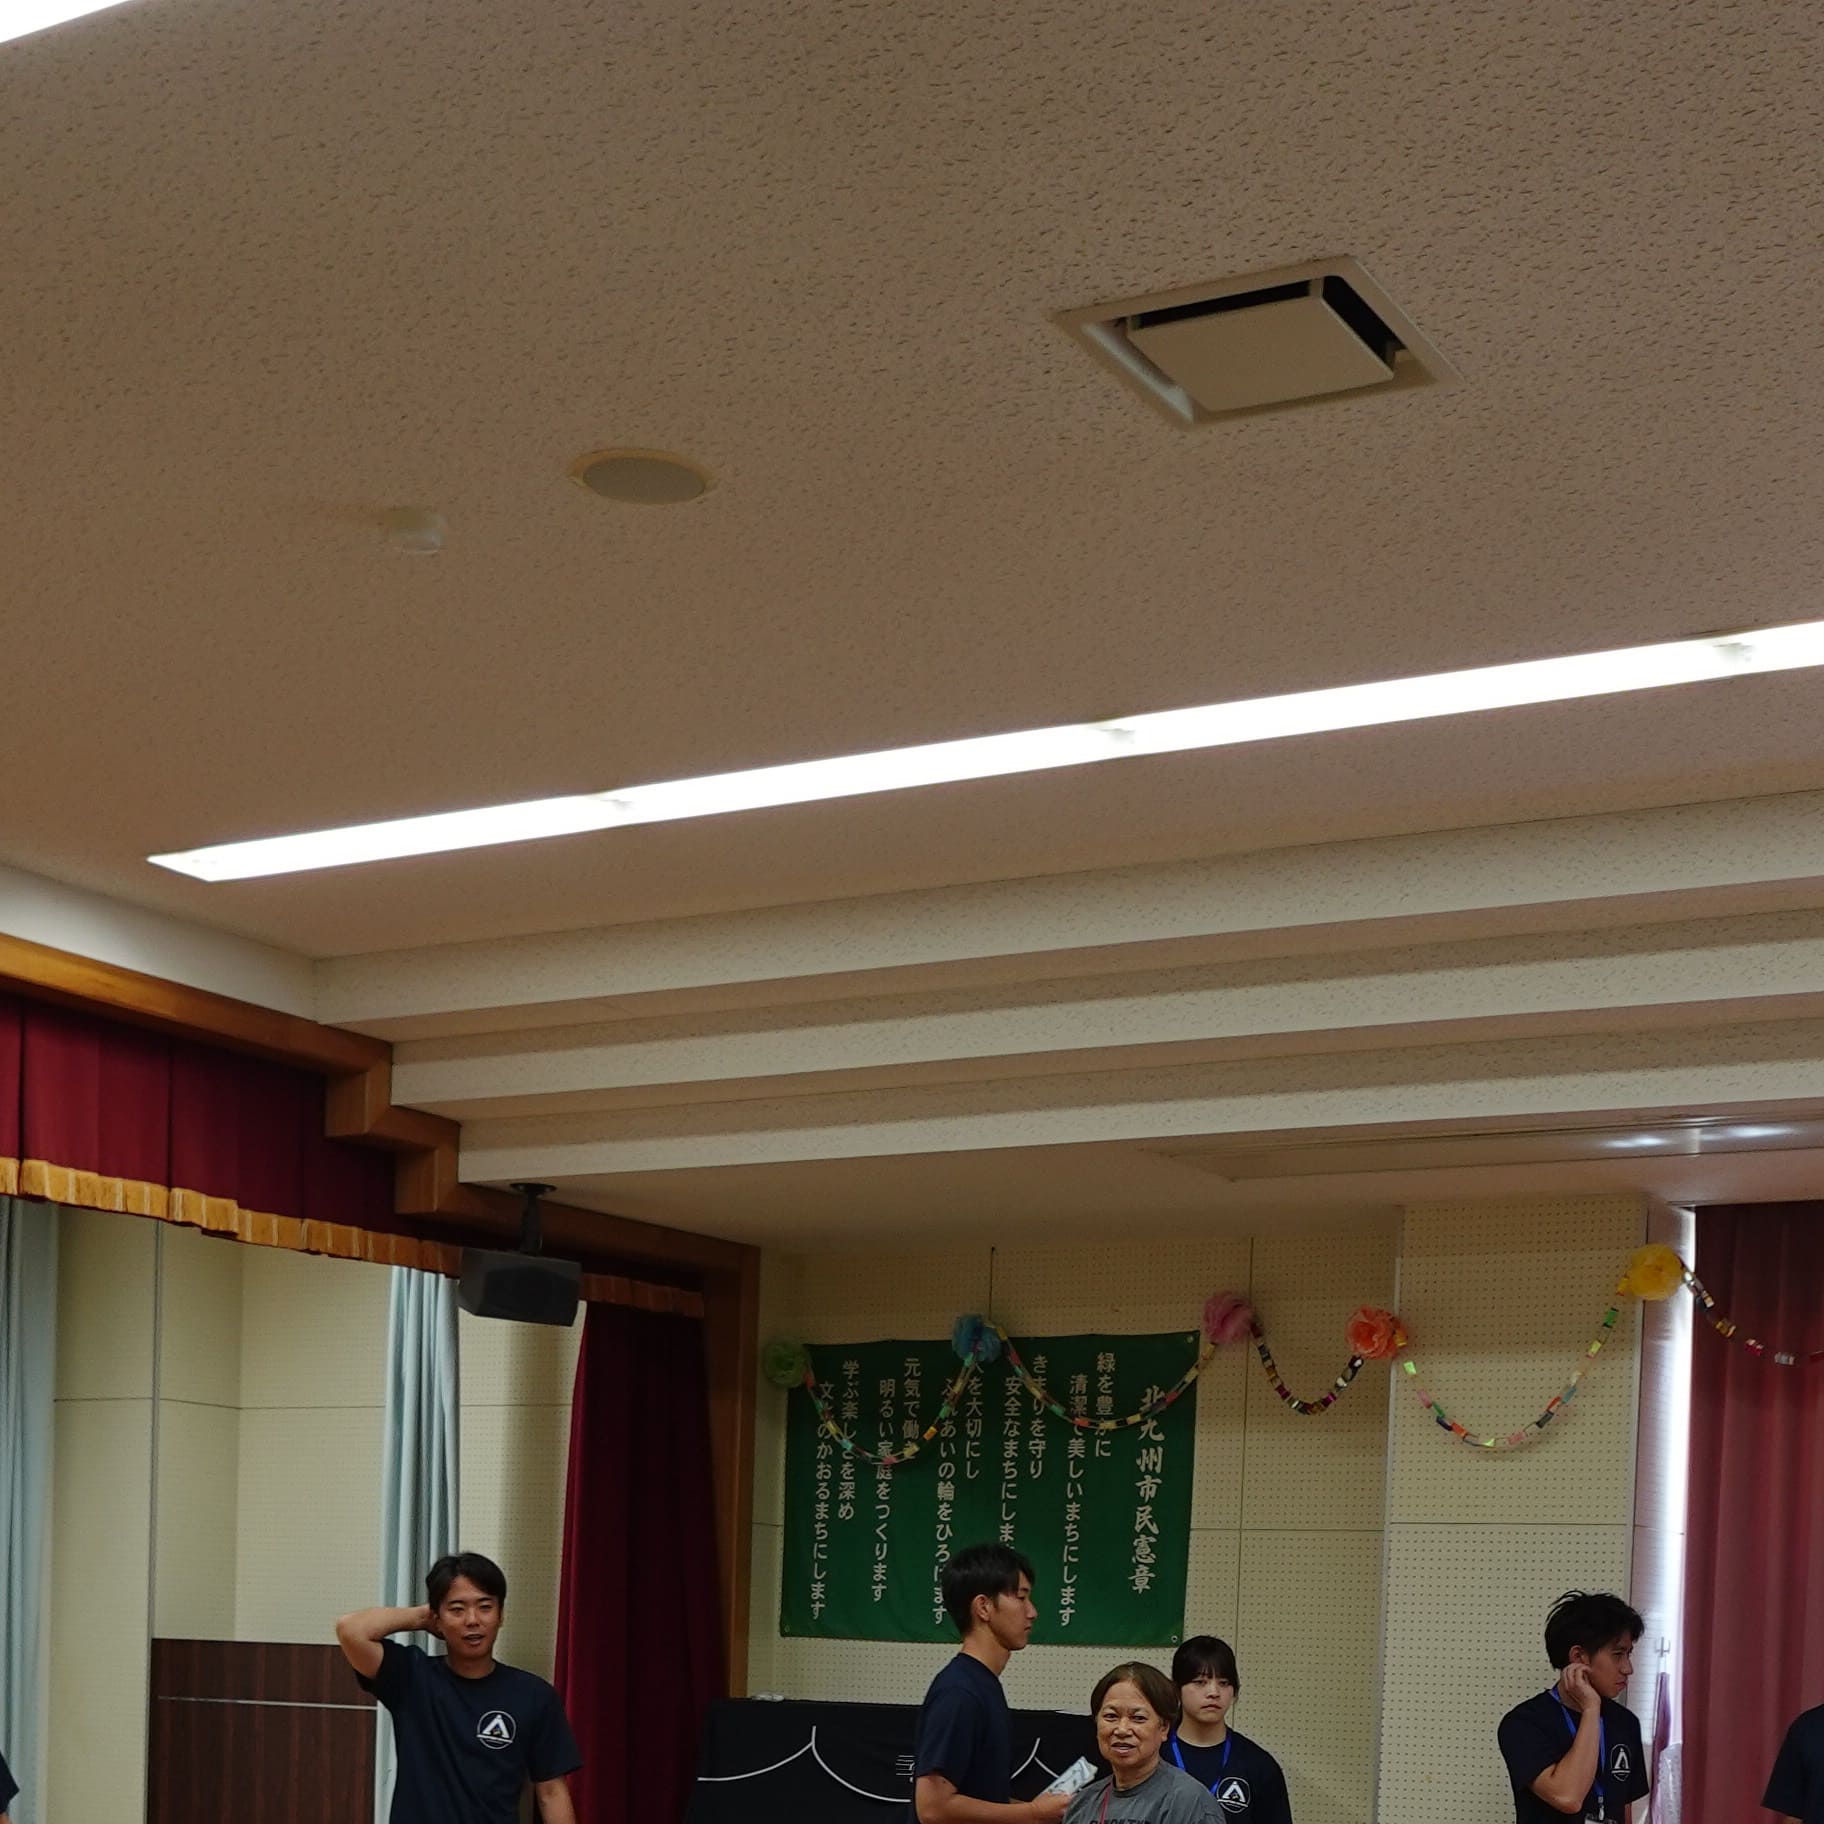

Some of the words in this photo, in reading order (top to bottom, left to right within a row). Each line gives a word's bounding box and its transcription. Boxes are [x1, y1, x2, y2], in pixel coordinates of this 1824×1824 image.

[810, 1381, 836, 1620] 文のかおるまちにします
[999, 1375, 1025, 1550] 安全なまちにしま
[1128, 1385, 1166, 1594] 北九州市民憲章
